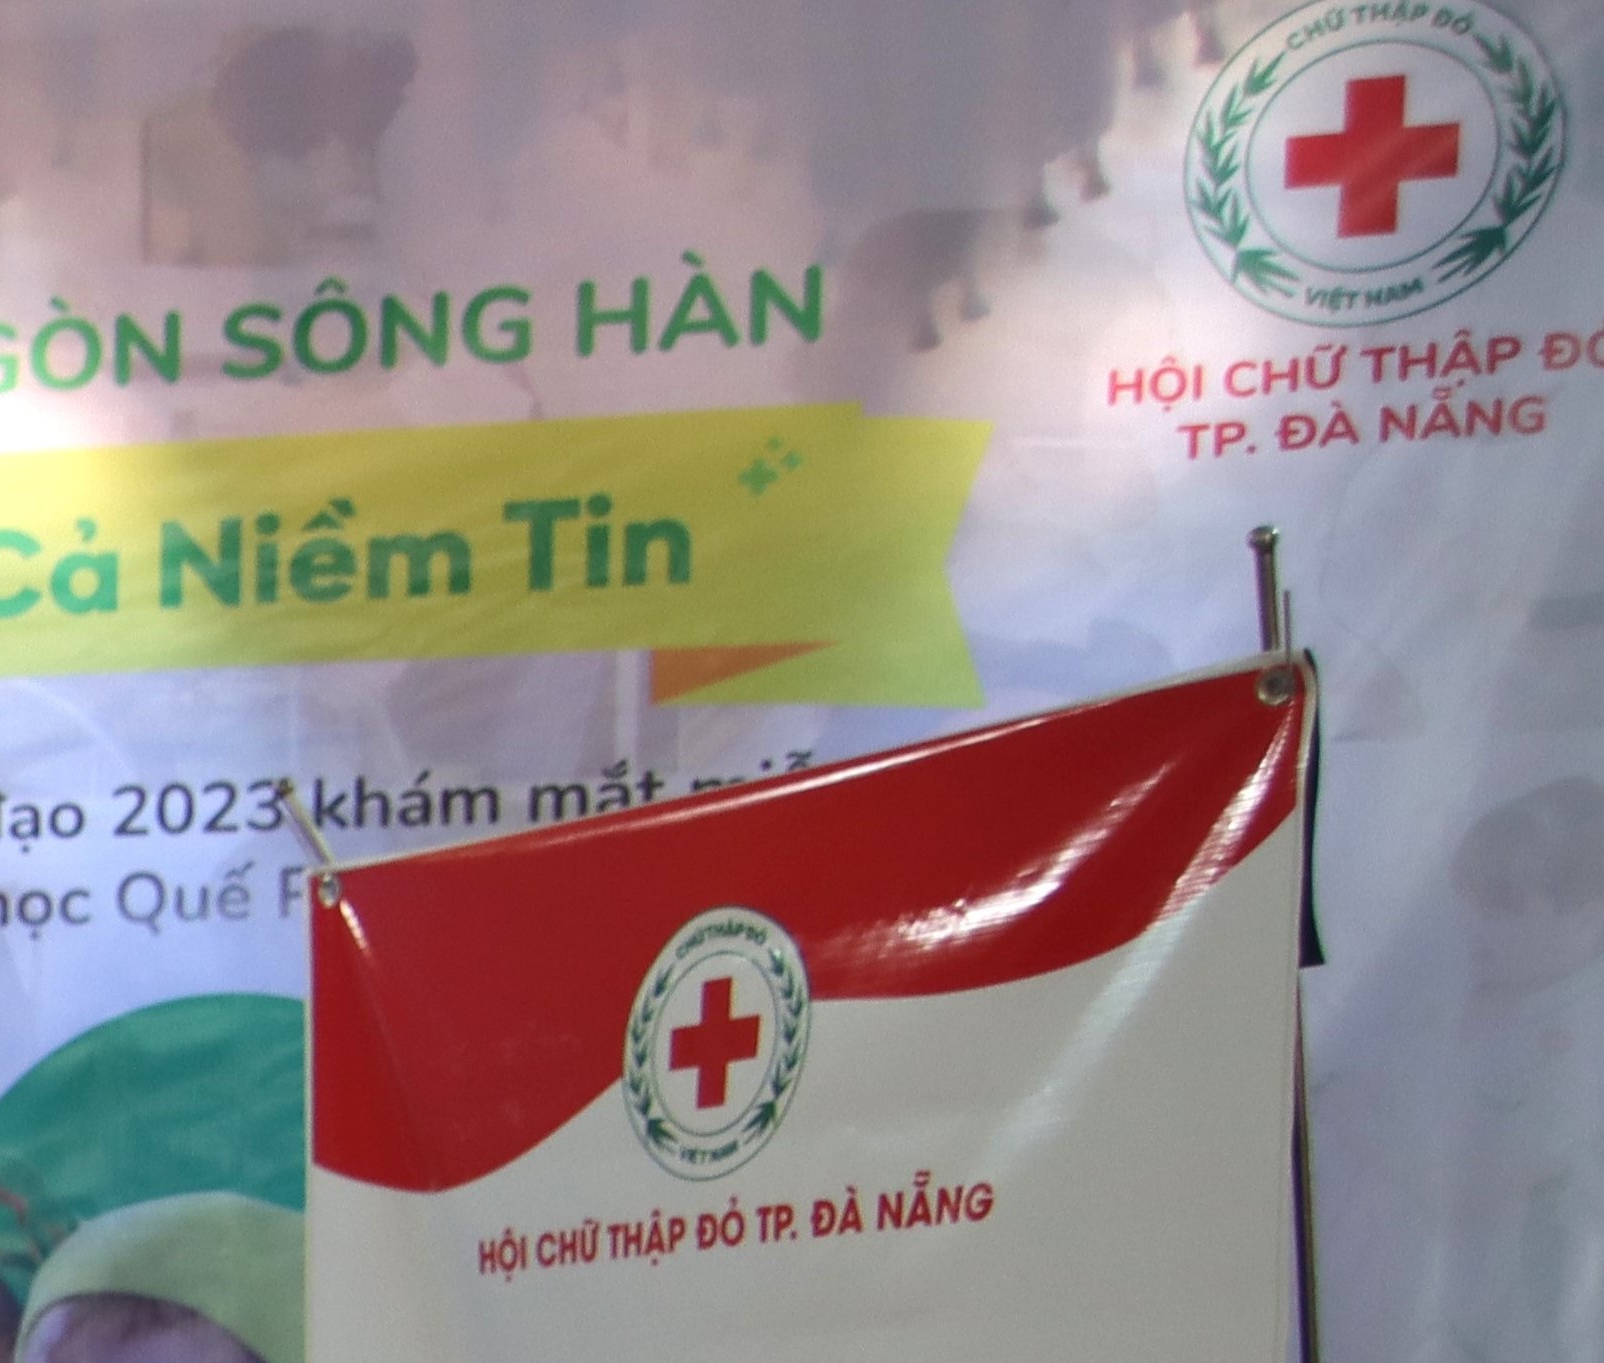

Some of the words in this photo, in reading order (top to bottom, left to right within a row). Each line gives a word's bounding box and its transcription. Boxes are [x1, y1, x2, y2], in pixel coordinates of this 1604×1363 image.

[221, 279, 532, 381] SÔNG
[576, 251, 824, 357] HÀN
[1107, 356, 1203, 412] HỘI
[1224, 344, 1349, 398] CHỮ
[1359, 328, 1523, 388] THẬP
[1177, 420, 1257, 460] TP.
[1274, 401, 1360, 452] ĐÀ
[1380, 385, 1546, 443] NẴNG
[160, 499, 472, 611] Niềm
[503, 492, 693, 593] Tin
[111, 780, 288, 838] 2023
[313, 769, 502, 830] khám
[114, 861, 253, 927] Quế
[478, 1228, 529, 1283] HỘI
[536, 1219, 600, 1268] CHỮ
[607, 1209, 688, 1267] THẬP
[696, 1196, 746, 1252] ĐỎ
[755, 1200, 796, 1242] TP.
[811, 1186, 864, 1239] ĐÀ
[876, 1169, 996, 1232] NẴNG
